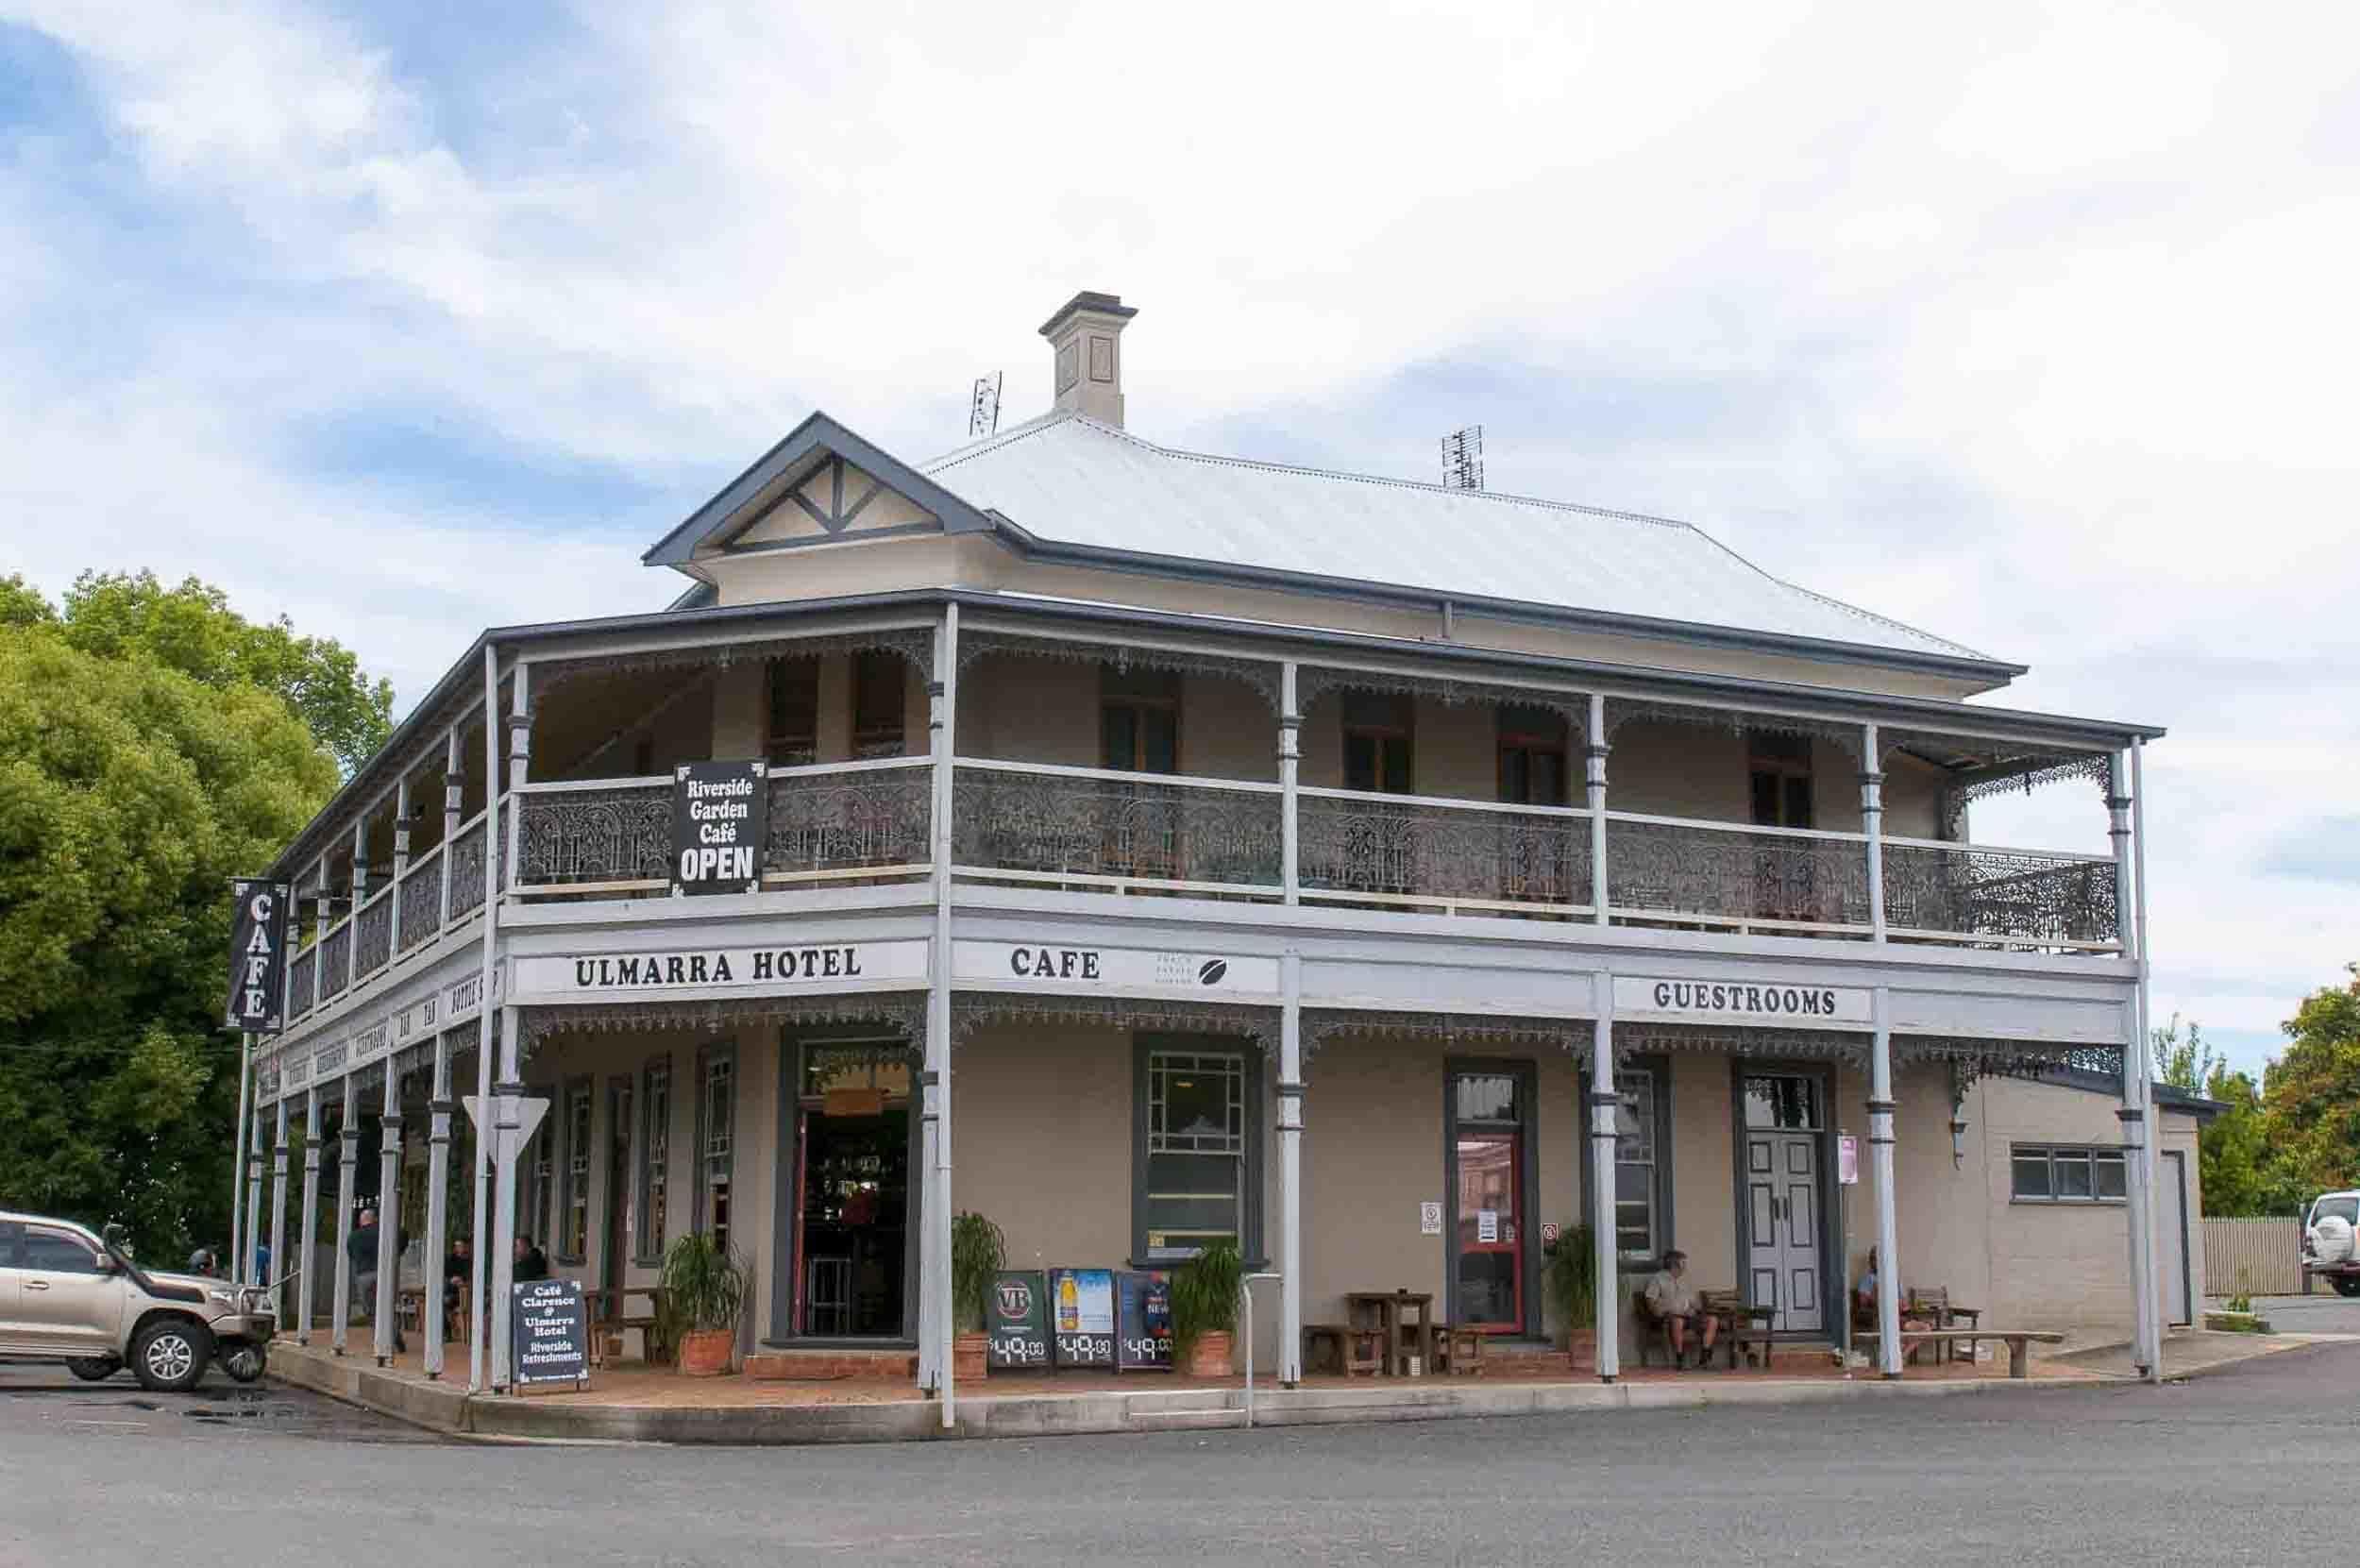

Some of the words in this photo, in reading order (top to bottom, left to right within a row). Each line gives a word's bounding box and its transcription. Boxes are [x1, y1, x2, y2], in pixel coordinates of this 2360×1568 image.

[687, 778, 753, 798] Riverside
[690, 800, 748, 820] Garden
[700, 821, 737, 843] Café
[681, 846, 754, 881] OPEN
[246, 895, 273, 1018] CAFE
[1010, 947, 1101, 979] CAFE
[576, 952, 733, 986] ULMARRA
[752, 948, 862, 979] HOTEL
[1653, 983, 1836, 1015] GUESTROOMS
[533, 1285, 562, 1296] Café
[522, 1297, 575, 1307] Clarence
[525, 1317, 575, 1327] Ulmarra
[534, 1326, 567, 1337] Hotel
[531, 1340, 573, 1353] Riverside
[1057, 1336, 1111, 1361] $49.00
[522, 1352, 582, 1364] Refreshments
